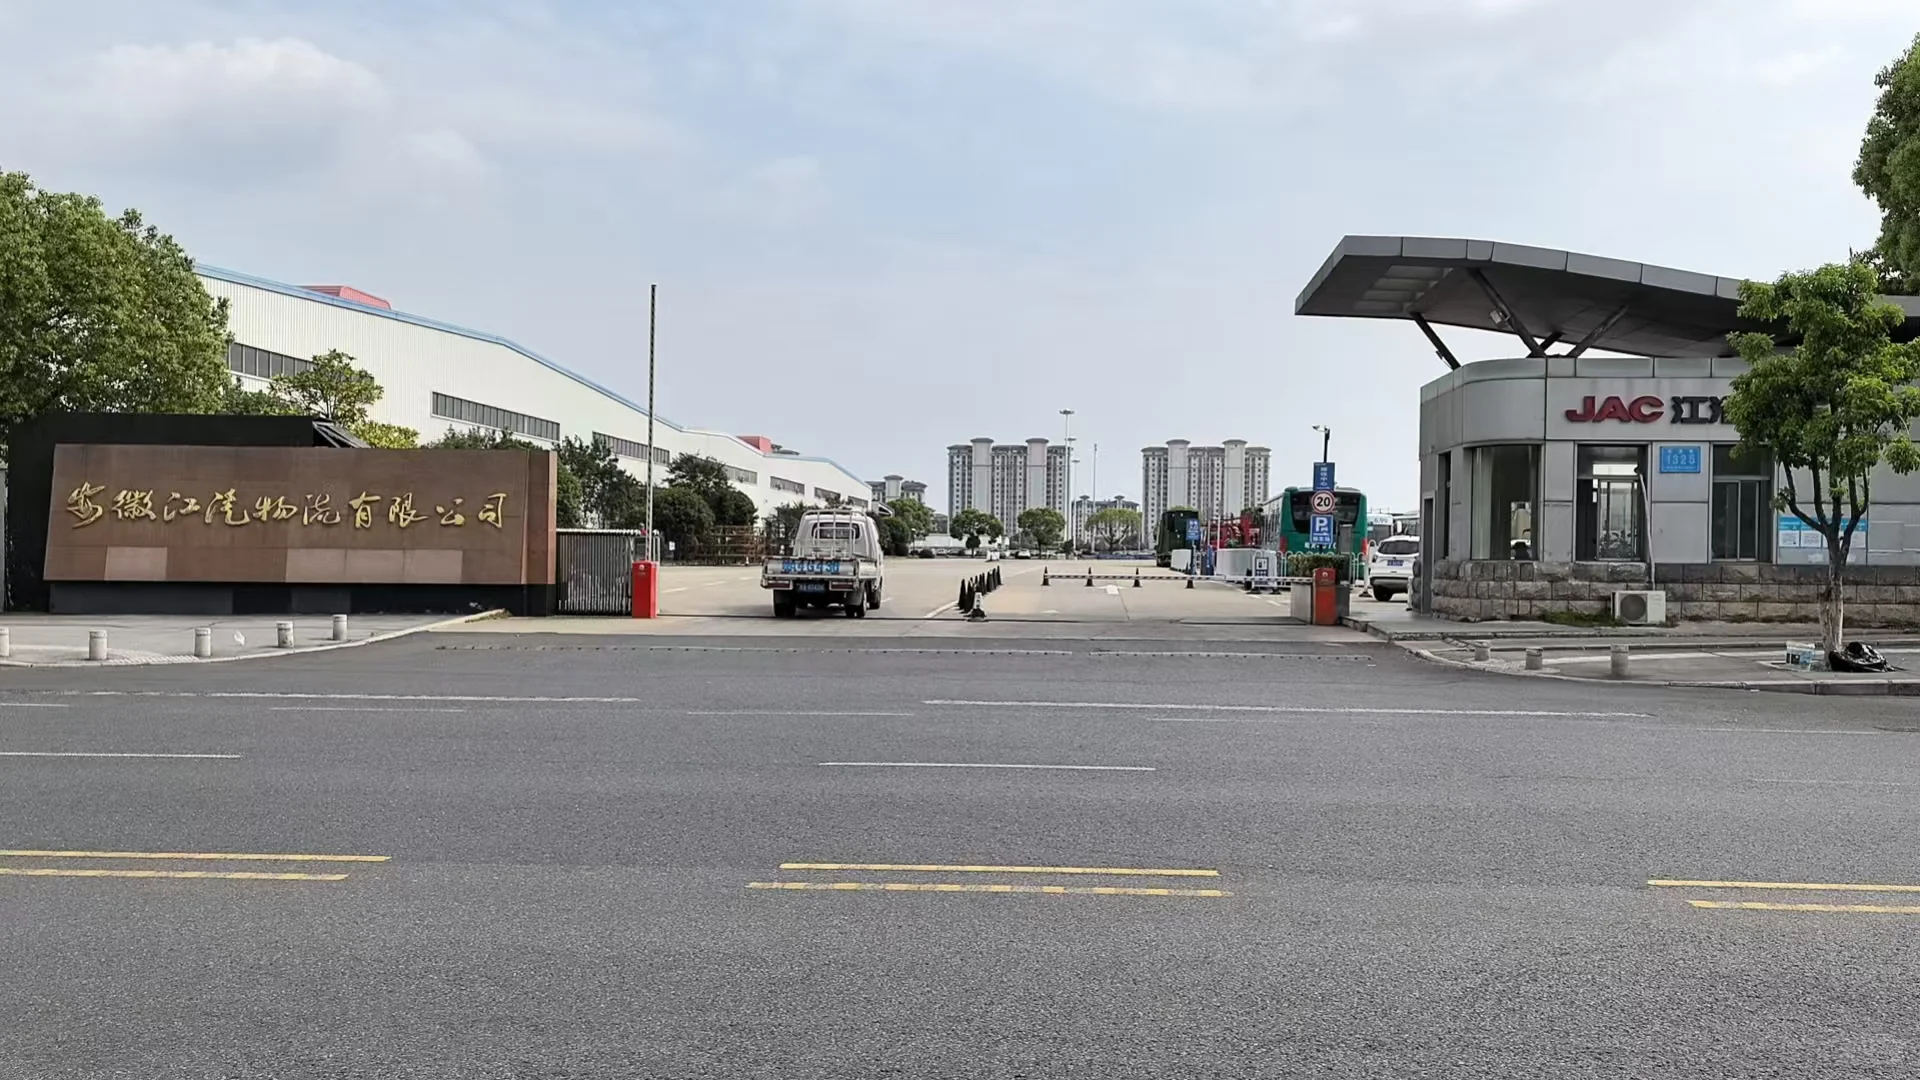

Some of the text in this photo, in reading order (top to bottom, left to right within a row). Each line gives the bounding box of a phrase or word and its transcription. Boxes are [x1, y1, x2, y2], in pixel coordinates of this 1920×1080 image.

[1565, 395, 1665, 423] JAC
[1667, 453, 1697, 465] 1325
[66, 481, 508, 530] 安徽江汽物流有限公司
[1316, 496, 1331, 507] 20
[1315, 517, 1329, 532] P
